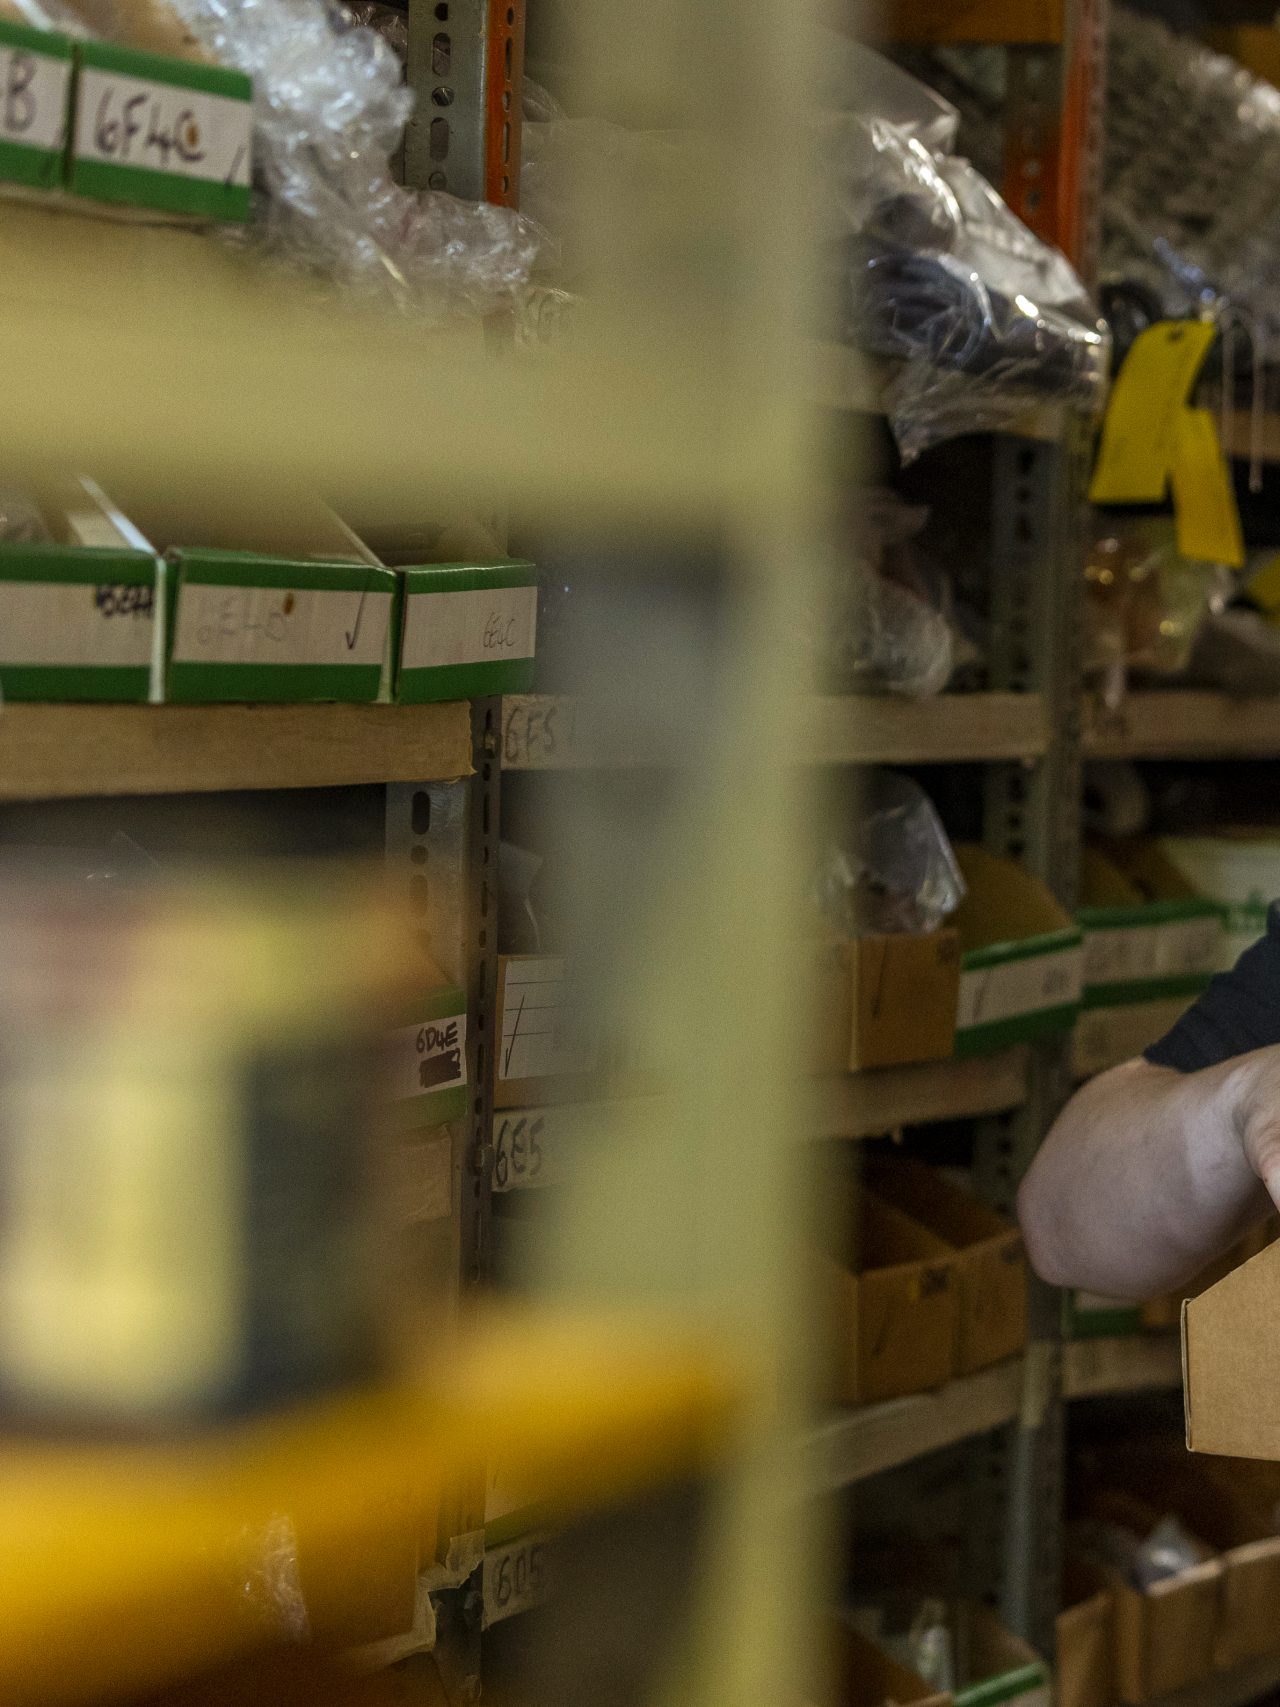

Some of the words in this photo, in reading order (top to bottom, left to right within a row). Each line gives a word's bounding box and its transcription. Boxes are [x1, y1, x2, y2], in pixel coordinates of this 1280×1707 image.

[94, 87, 206, 169] 6F4C
[415, 1021, 459, 1053] 6D4E
[495, 1114, 545, 1187] 6E5
